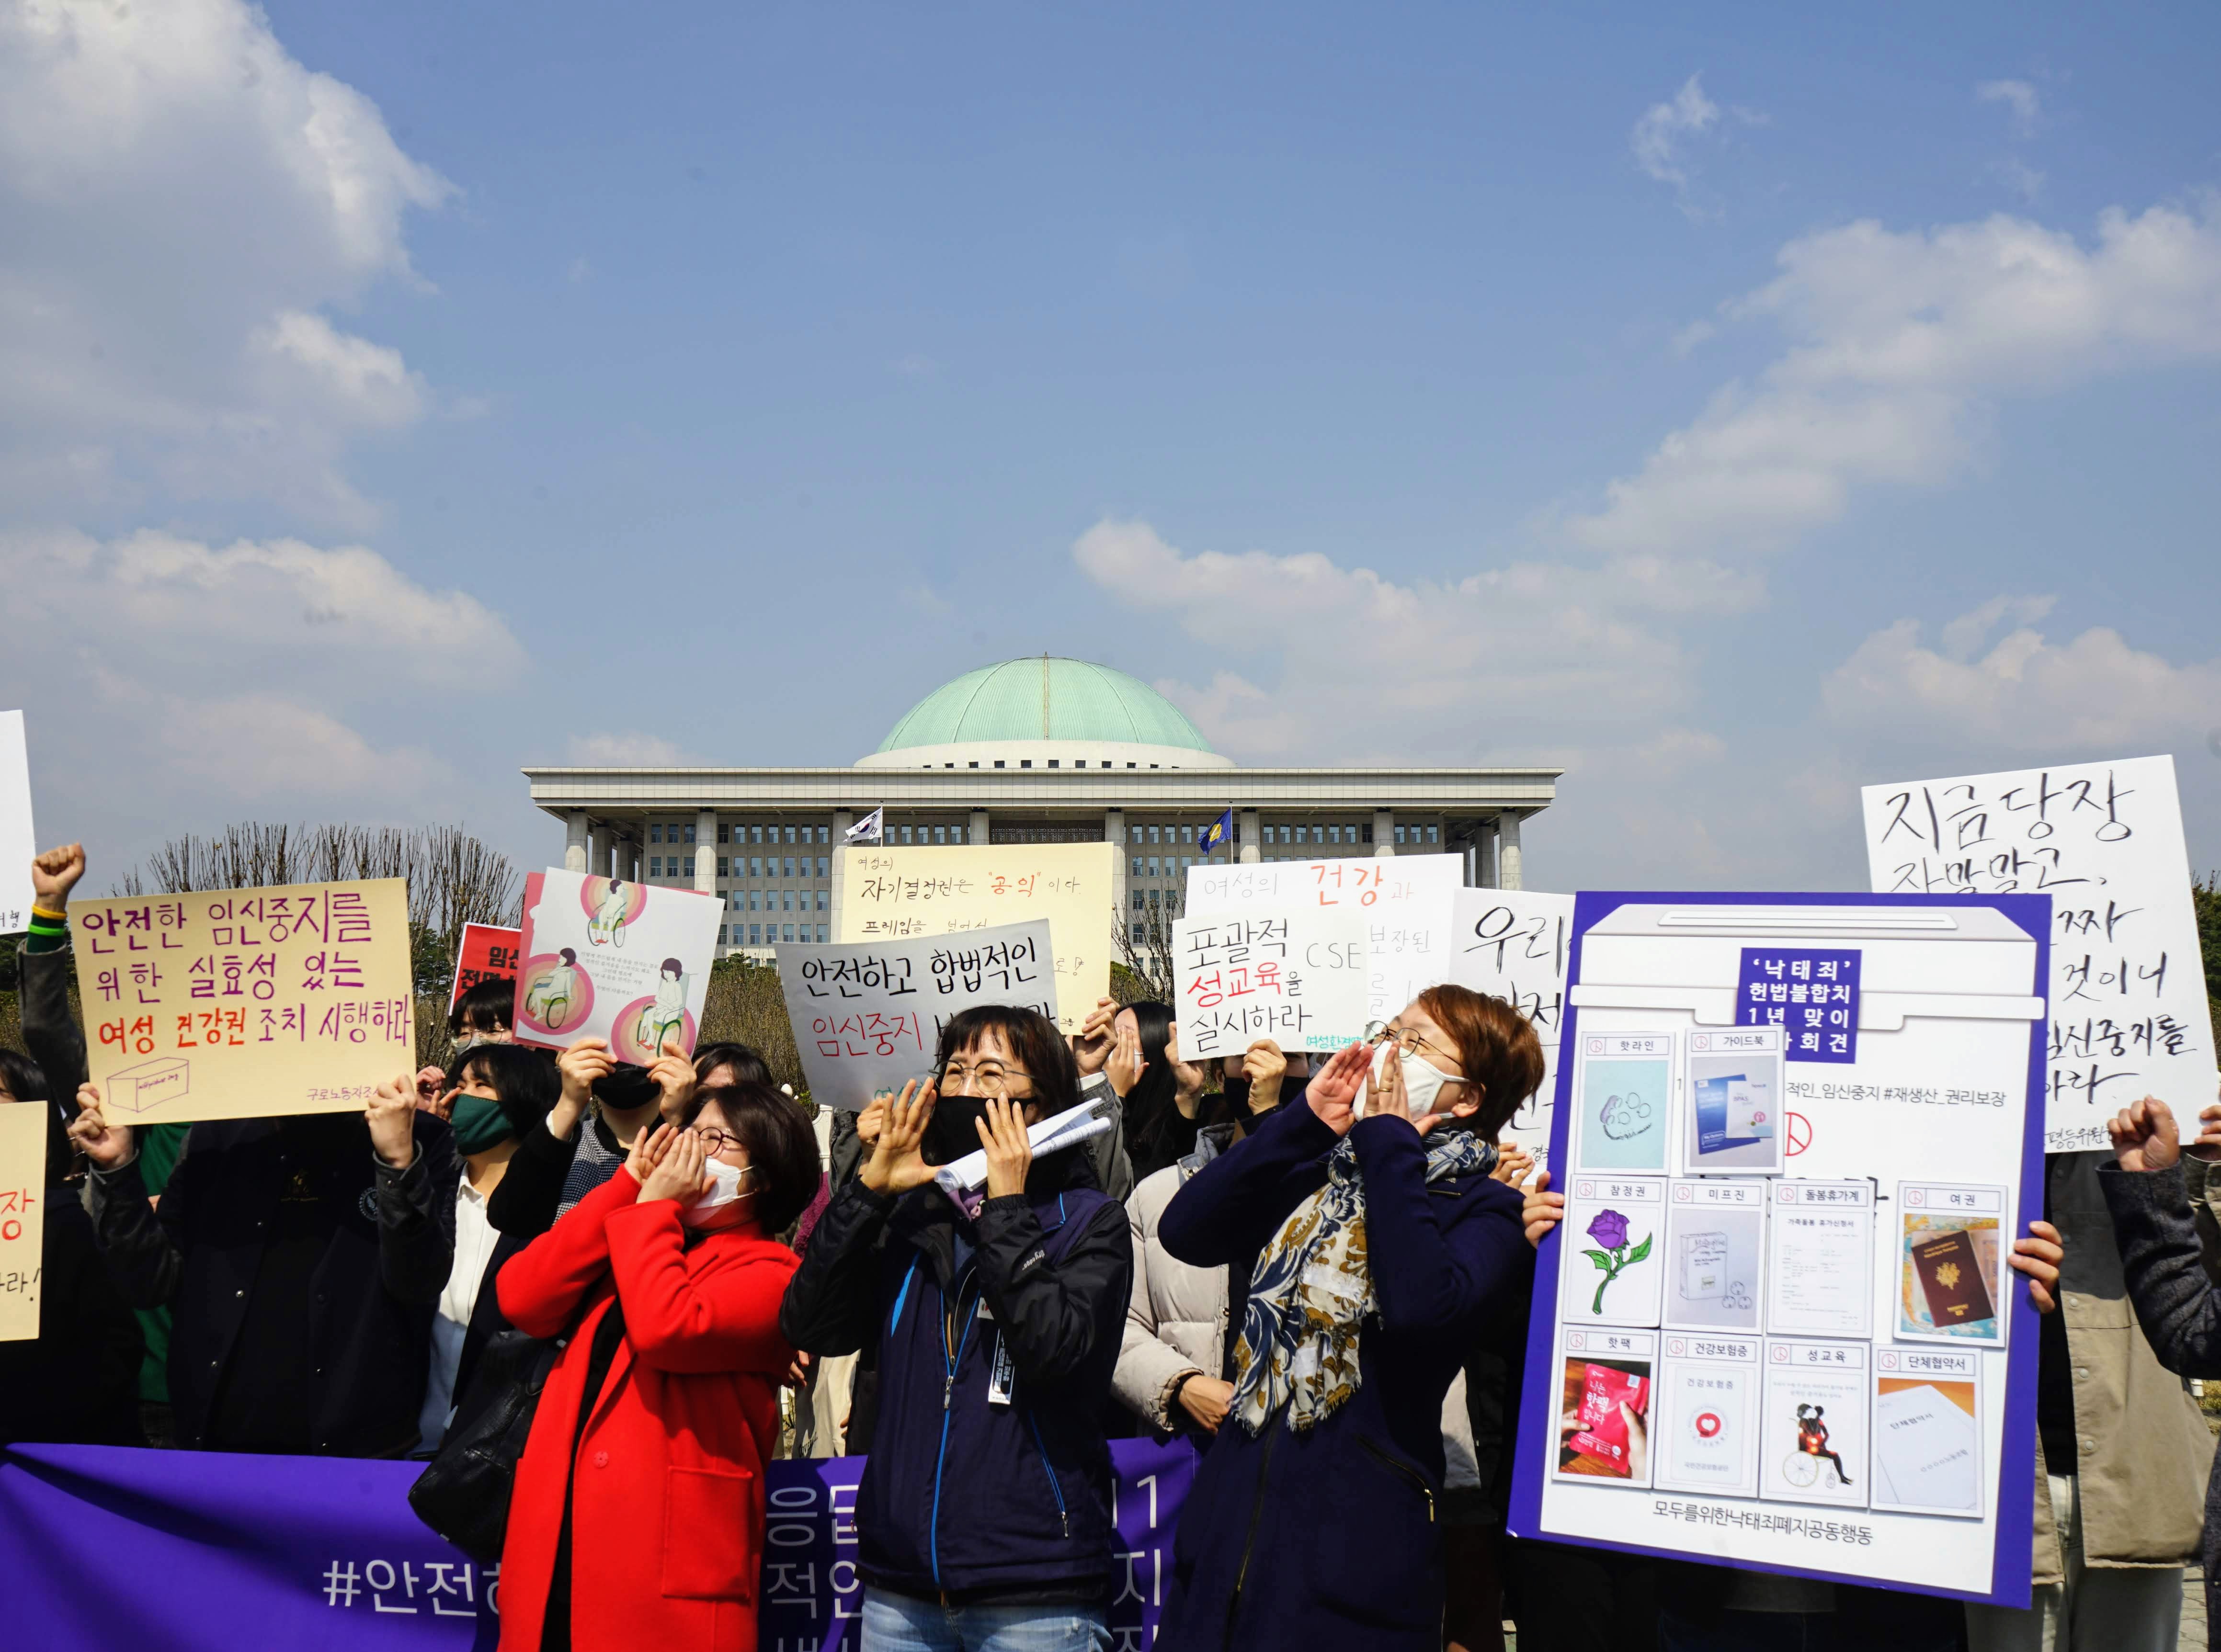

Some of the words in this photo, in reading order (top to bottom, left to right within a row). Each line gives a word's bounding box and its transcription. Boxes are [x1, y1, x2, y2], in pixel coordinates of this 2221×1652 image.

[1882, 786, 1995, 855] 지금
[1999, 769, 2135, 842] 당장
[857, 856, 893, 871] 여성의
[861, 876, 974, 903] 자기결정권은
[1204, 872, 1277, 898] 여성의
[82, 903, 187, 955] 안전한
[208, 890, 372, 946] 임신중지를
[861, 917, 926, 936] 프레임을
[2050, 900, 2144, 945] 짜
[1186, 918, 1288, 970] 포괄적
[1306, 942, 1362, 969] CSE
[1369, 924, 1431, 954] 보장된
[1463, 906, 1571, 978] 우리
[97, 963, 163, 1004] 위한
[188, 951, 277, 1000] 실효성
[302, 951, 365, 991] 있는
[802, 955, 917, 998] 안전하고
[930, 937, 1037, 995] 합법적인
[1187, 961, 1303, 1007] 성교육을
[1749, 982, 1851, 1004] 헌법불합치
[99, 1014, 155, 1055] 여성
[176, 1007, 246, 1051] 건강권
[258, 1002, 307, 1043] 조치
[319, 994, 412, 1048] 시행하라
[1189, 1004, 1313, 1052] 실시하라
[1804, 1008, 1849, 1029] 맞이
[813, 1011, 923, 1057] 임신중지
[1306, 1034, 1364, 1050] 여성환경
[1723, 1036, 1765, 1047] 가이드북
[1883, 1086, 2007, 1108] #재생산_권리보장
[1805, 1189, 1859, 1202] 돌봄휴가계
[1608, 1336, 1630, 1349] 핫팩
[1695, 1343, 1748, 1357] 건강보험증
[1908, 1355, 1966, 1371] 단체협약서
[1586, 1392, 1609, 1413] 핫팩
[1652, 1500, 1873, 1546] 모두를위한낙태죄폐지공동행동
